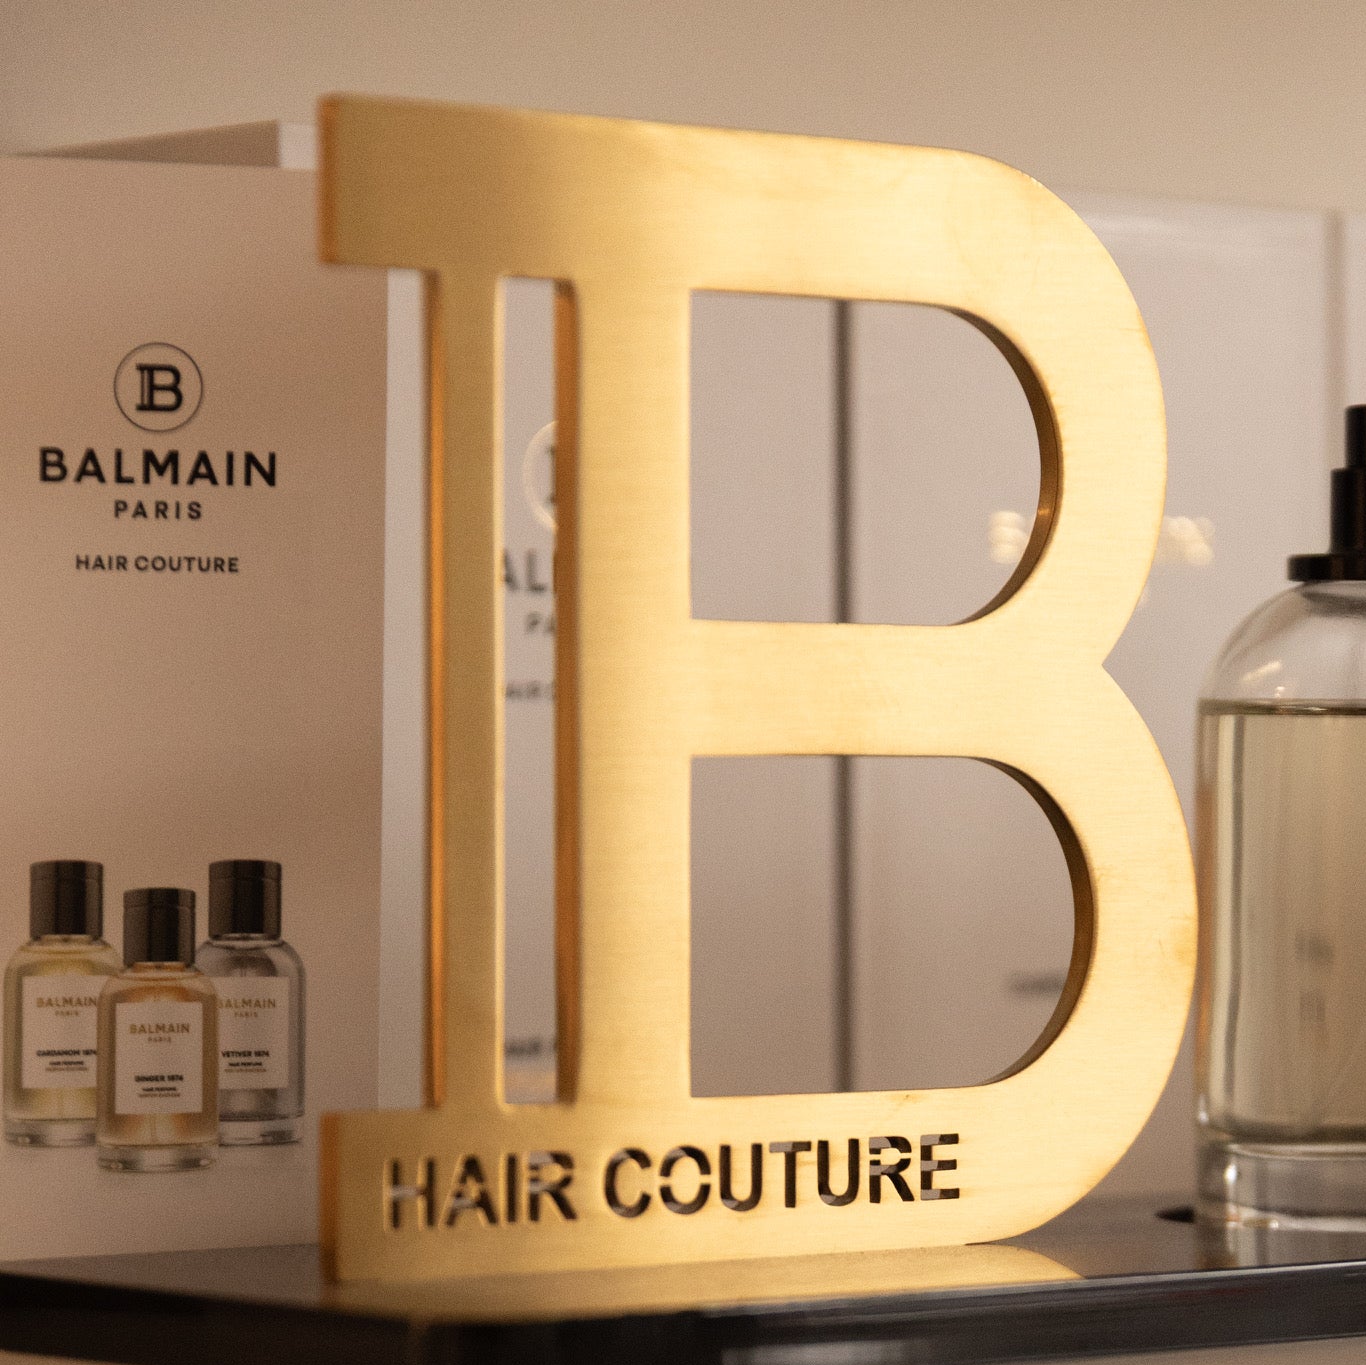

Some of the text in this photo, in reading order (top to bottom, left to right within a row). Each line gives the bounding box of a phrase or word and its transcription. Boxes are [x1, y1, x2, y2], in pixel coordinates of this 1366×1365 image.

[39, 446, 277, 487] BALMAIN
[114, 500, 204, 521] PARIS
[75, 554, 240, 573] HAIR COUTURE
[36, 997, 97, 1008] BALMAIN
[129, 1023, 190, 1034] BALMAIN
[386, 1132, 960, 1230] HAIR COUTURE
